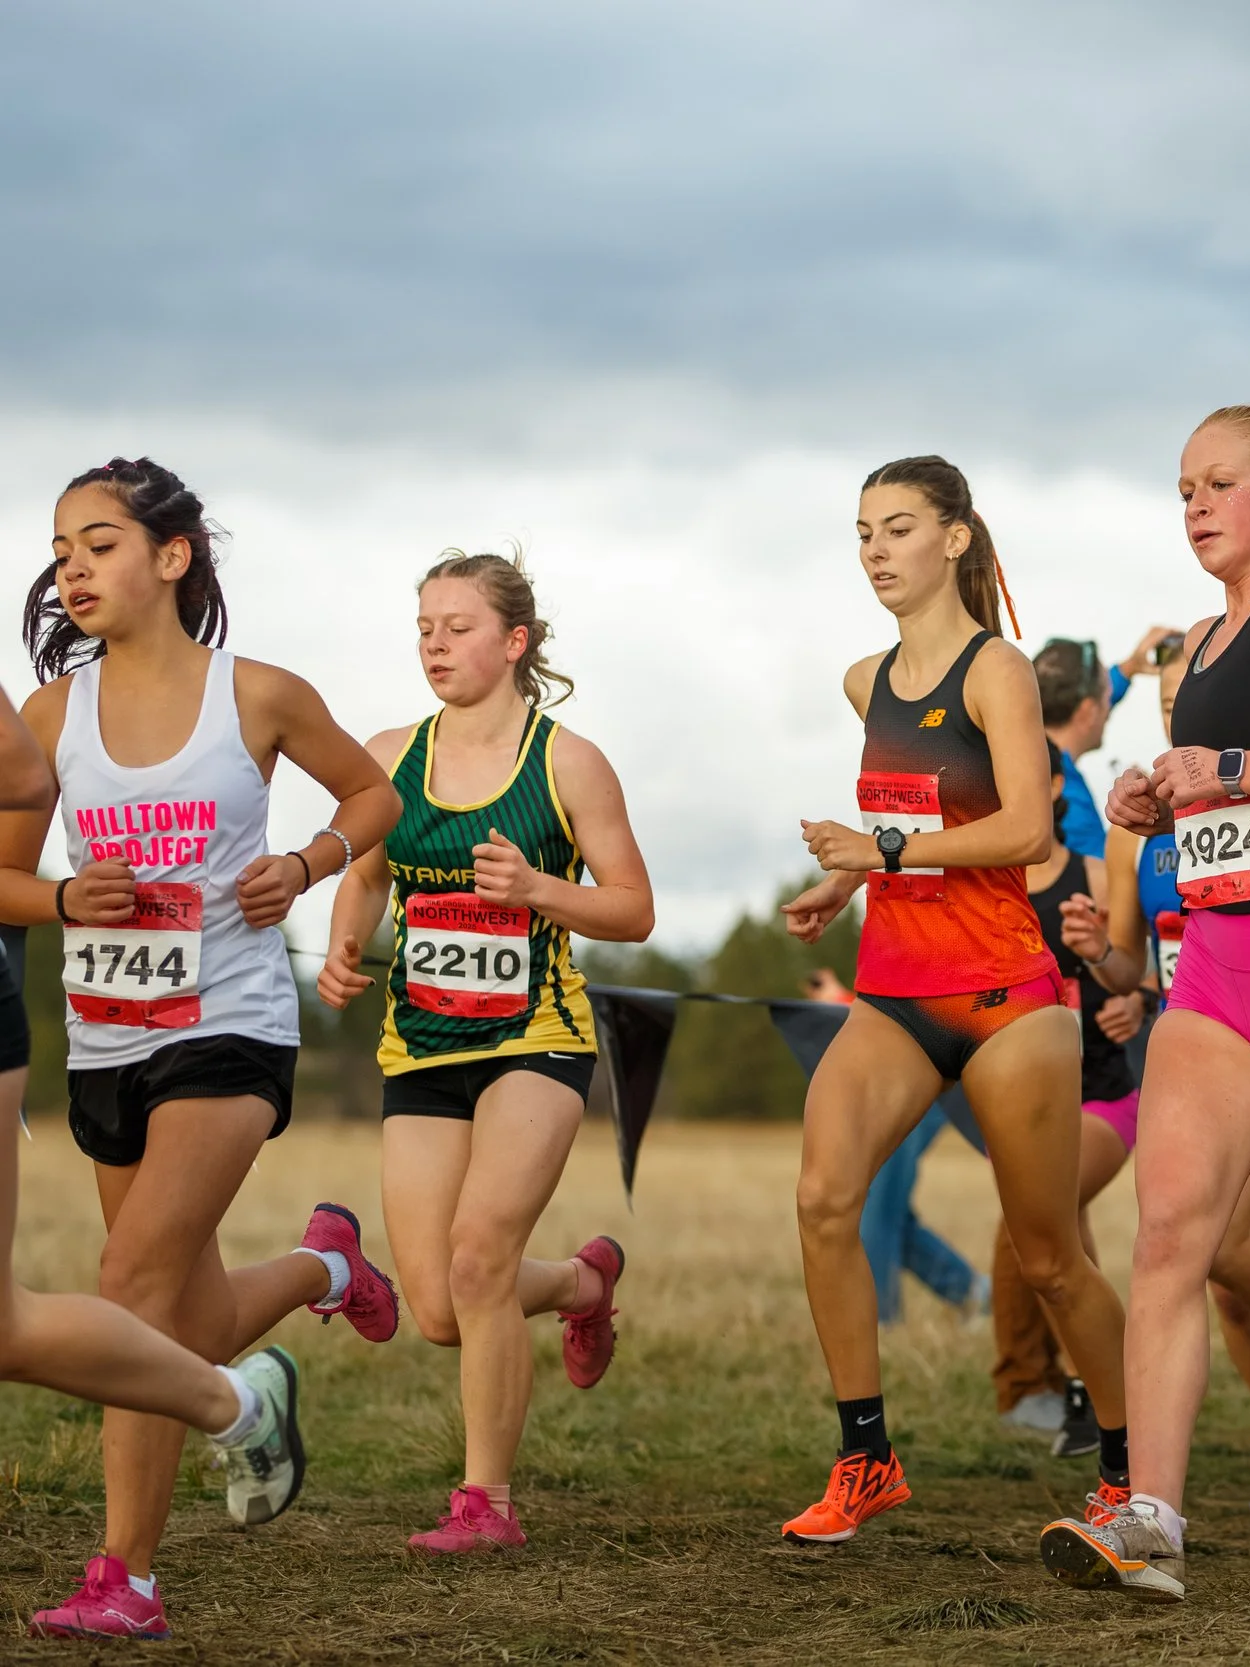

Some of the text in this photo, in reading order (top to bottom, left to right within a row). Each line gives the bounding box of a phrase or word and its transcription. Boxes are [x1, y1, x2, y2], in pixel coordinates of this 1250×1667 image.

[860, 788, 931, 804] NORTHWEST
[76, 801, 216, 838] MILLTOWN
[388, 860, 475, 885] STAMP
[413, 906, 520, 926] NORTHWEST
[458, 922, 476, 930] 2025
[77, 944, 187, 987] 1744
[412, 941, 521, 981] 2210
